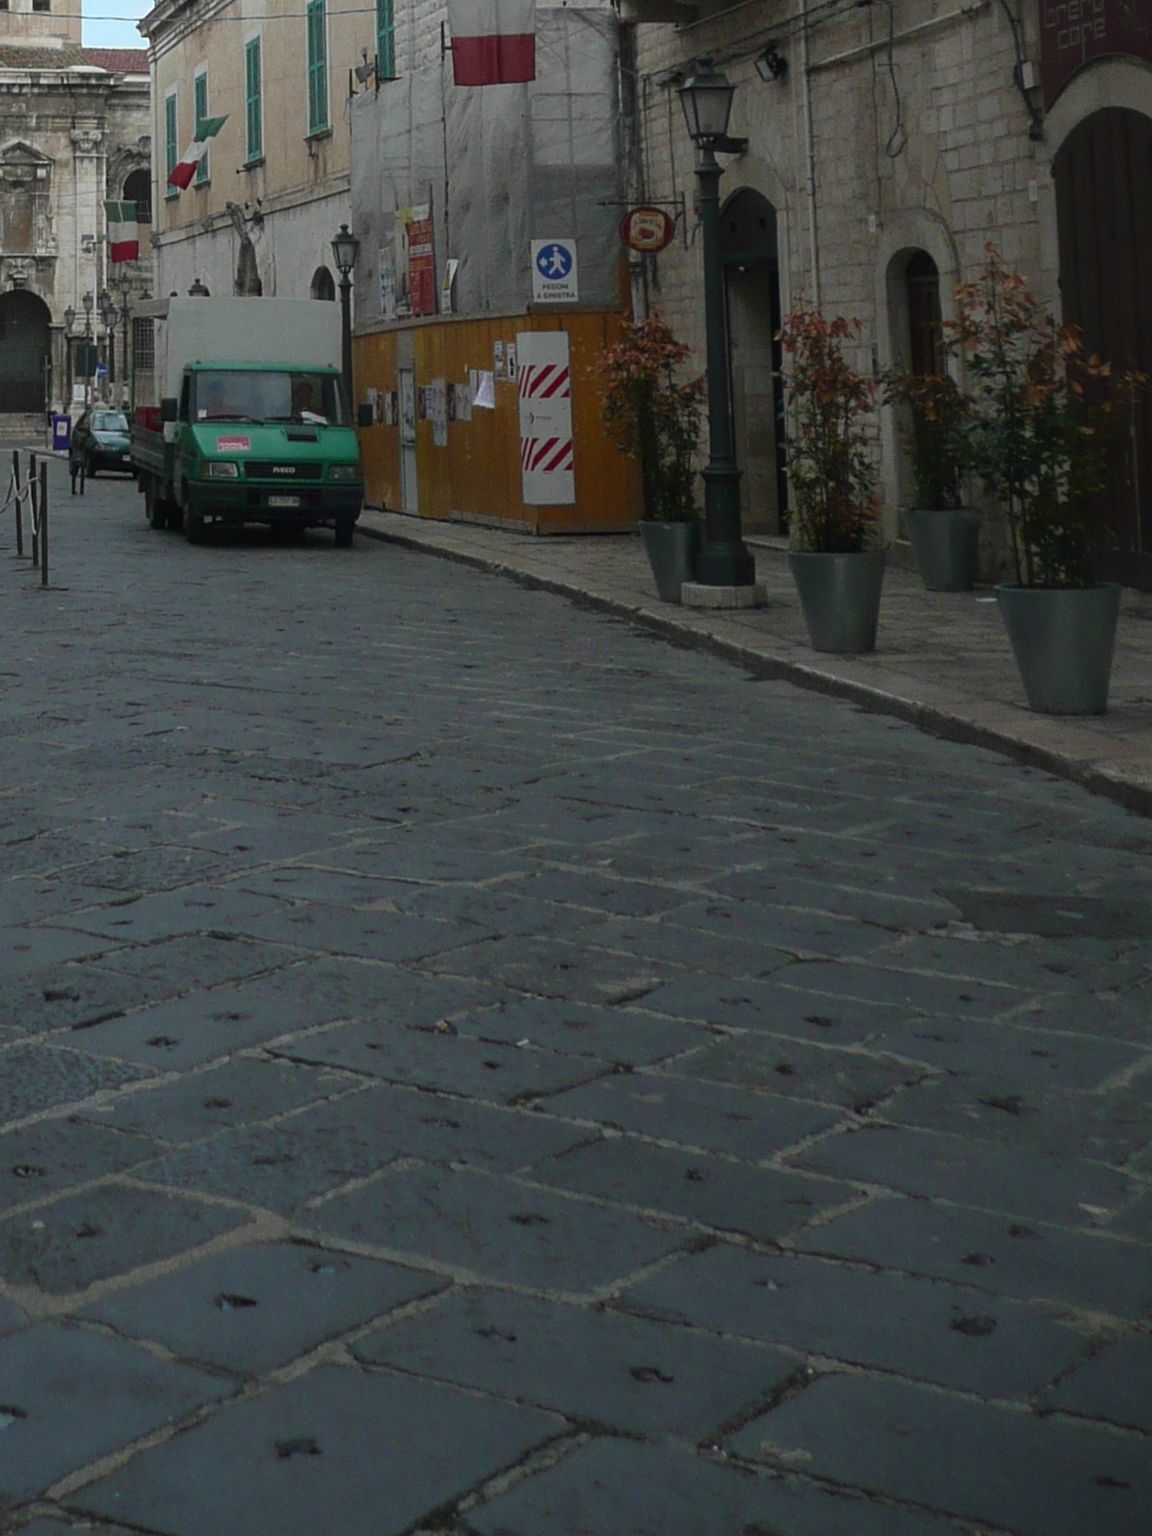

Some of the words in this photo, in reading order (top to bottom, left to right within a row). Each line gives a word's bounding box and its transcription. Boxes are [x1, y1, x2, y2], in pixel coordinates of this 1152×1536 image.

[542, 282, 569, 290] PEDONI
[543, 291, 575, 299] SINISTRA
[272, 466, 296, 474] IVECO
